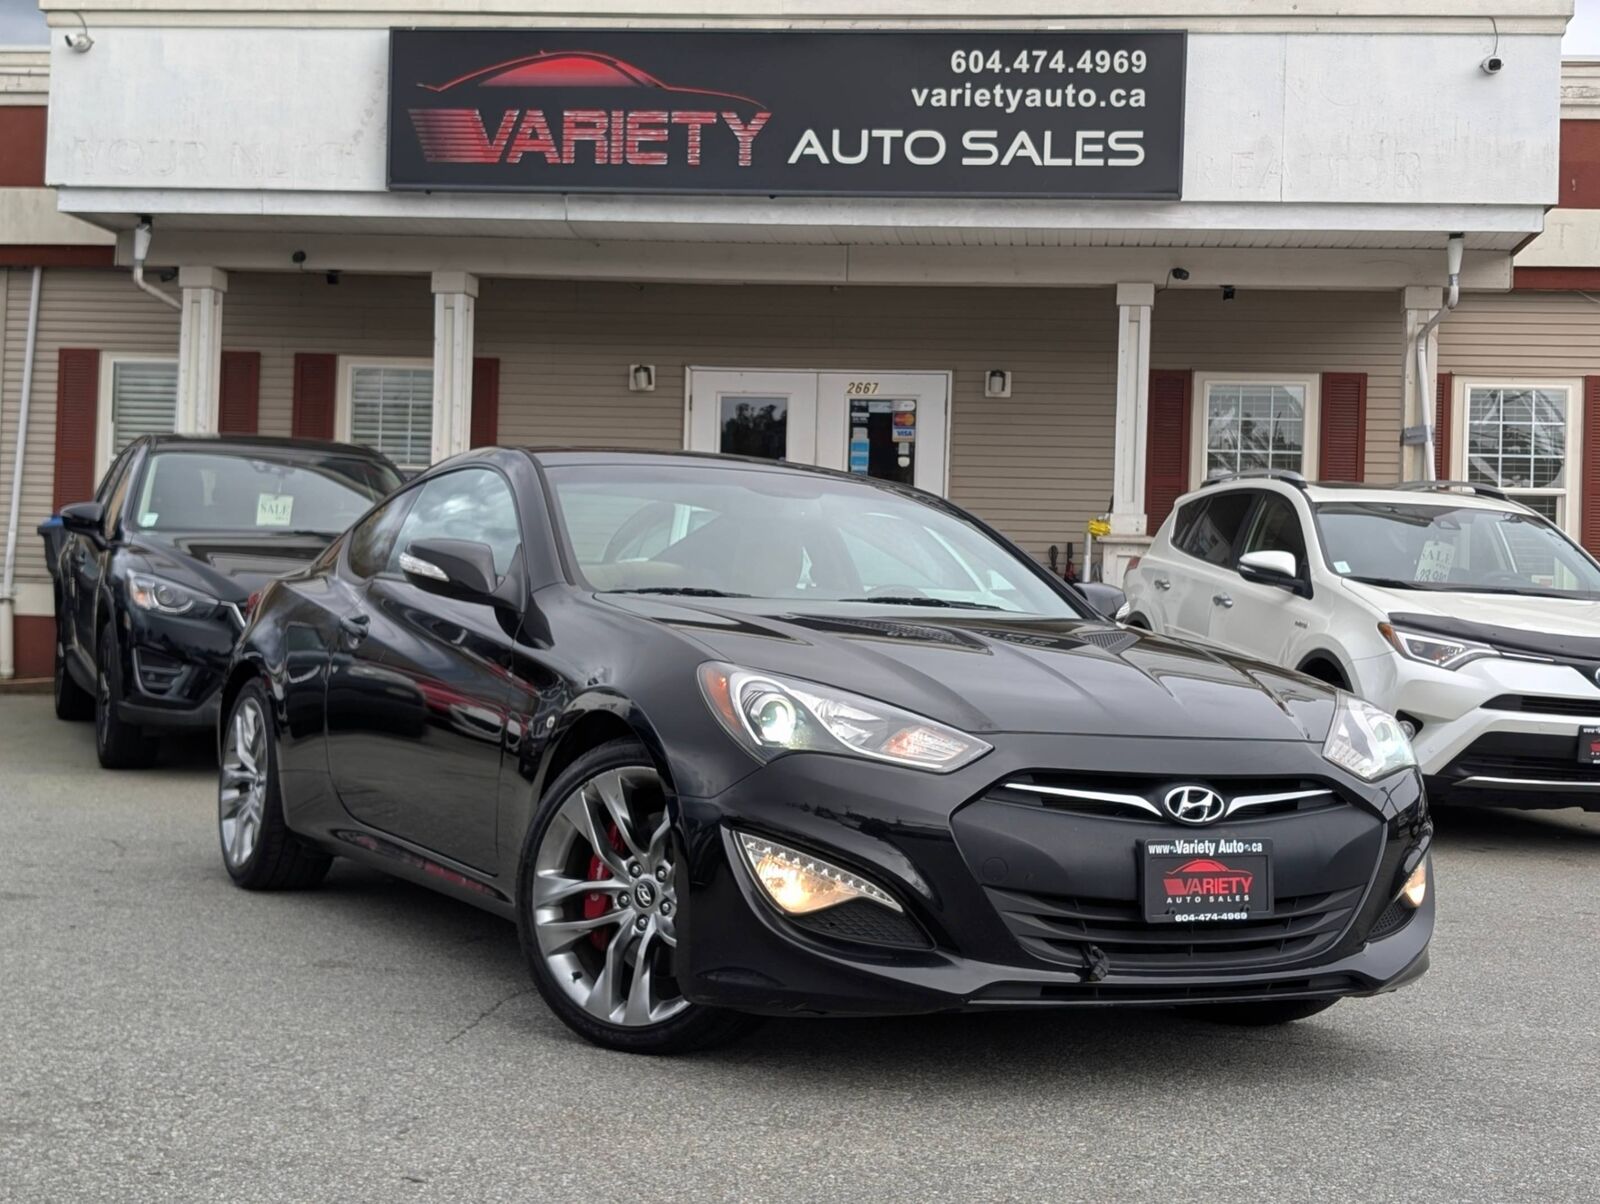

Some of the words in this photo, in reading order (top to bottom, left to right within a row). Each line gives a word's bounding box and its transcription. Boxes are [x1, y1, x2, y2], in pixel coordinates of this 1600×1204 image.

[951, 50, 1148, 74] 604.474.4969
[911, 83, 1147, 114] varietyauto.ca
[408, 108, 772, 166] VARIETY
[787, 129, 947, 165] AUTO
[961, 130, 1145, 166] SALES
[847, 382, 879, 394] 2667
[1163, 877, 1252, 895] VARIETY
[1166, 896, 1201, 904] AUTO
[1209, 894, 1250, 903] SALES
[1174, 912, 1248, 922] 604-474-4969
